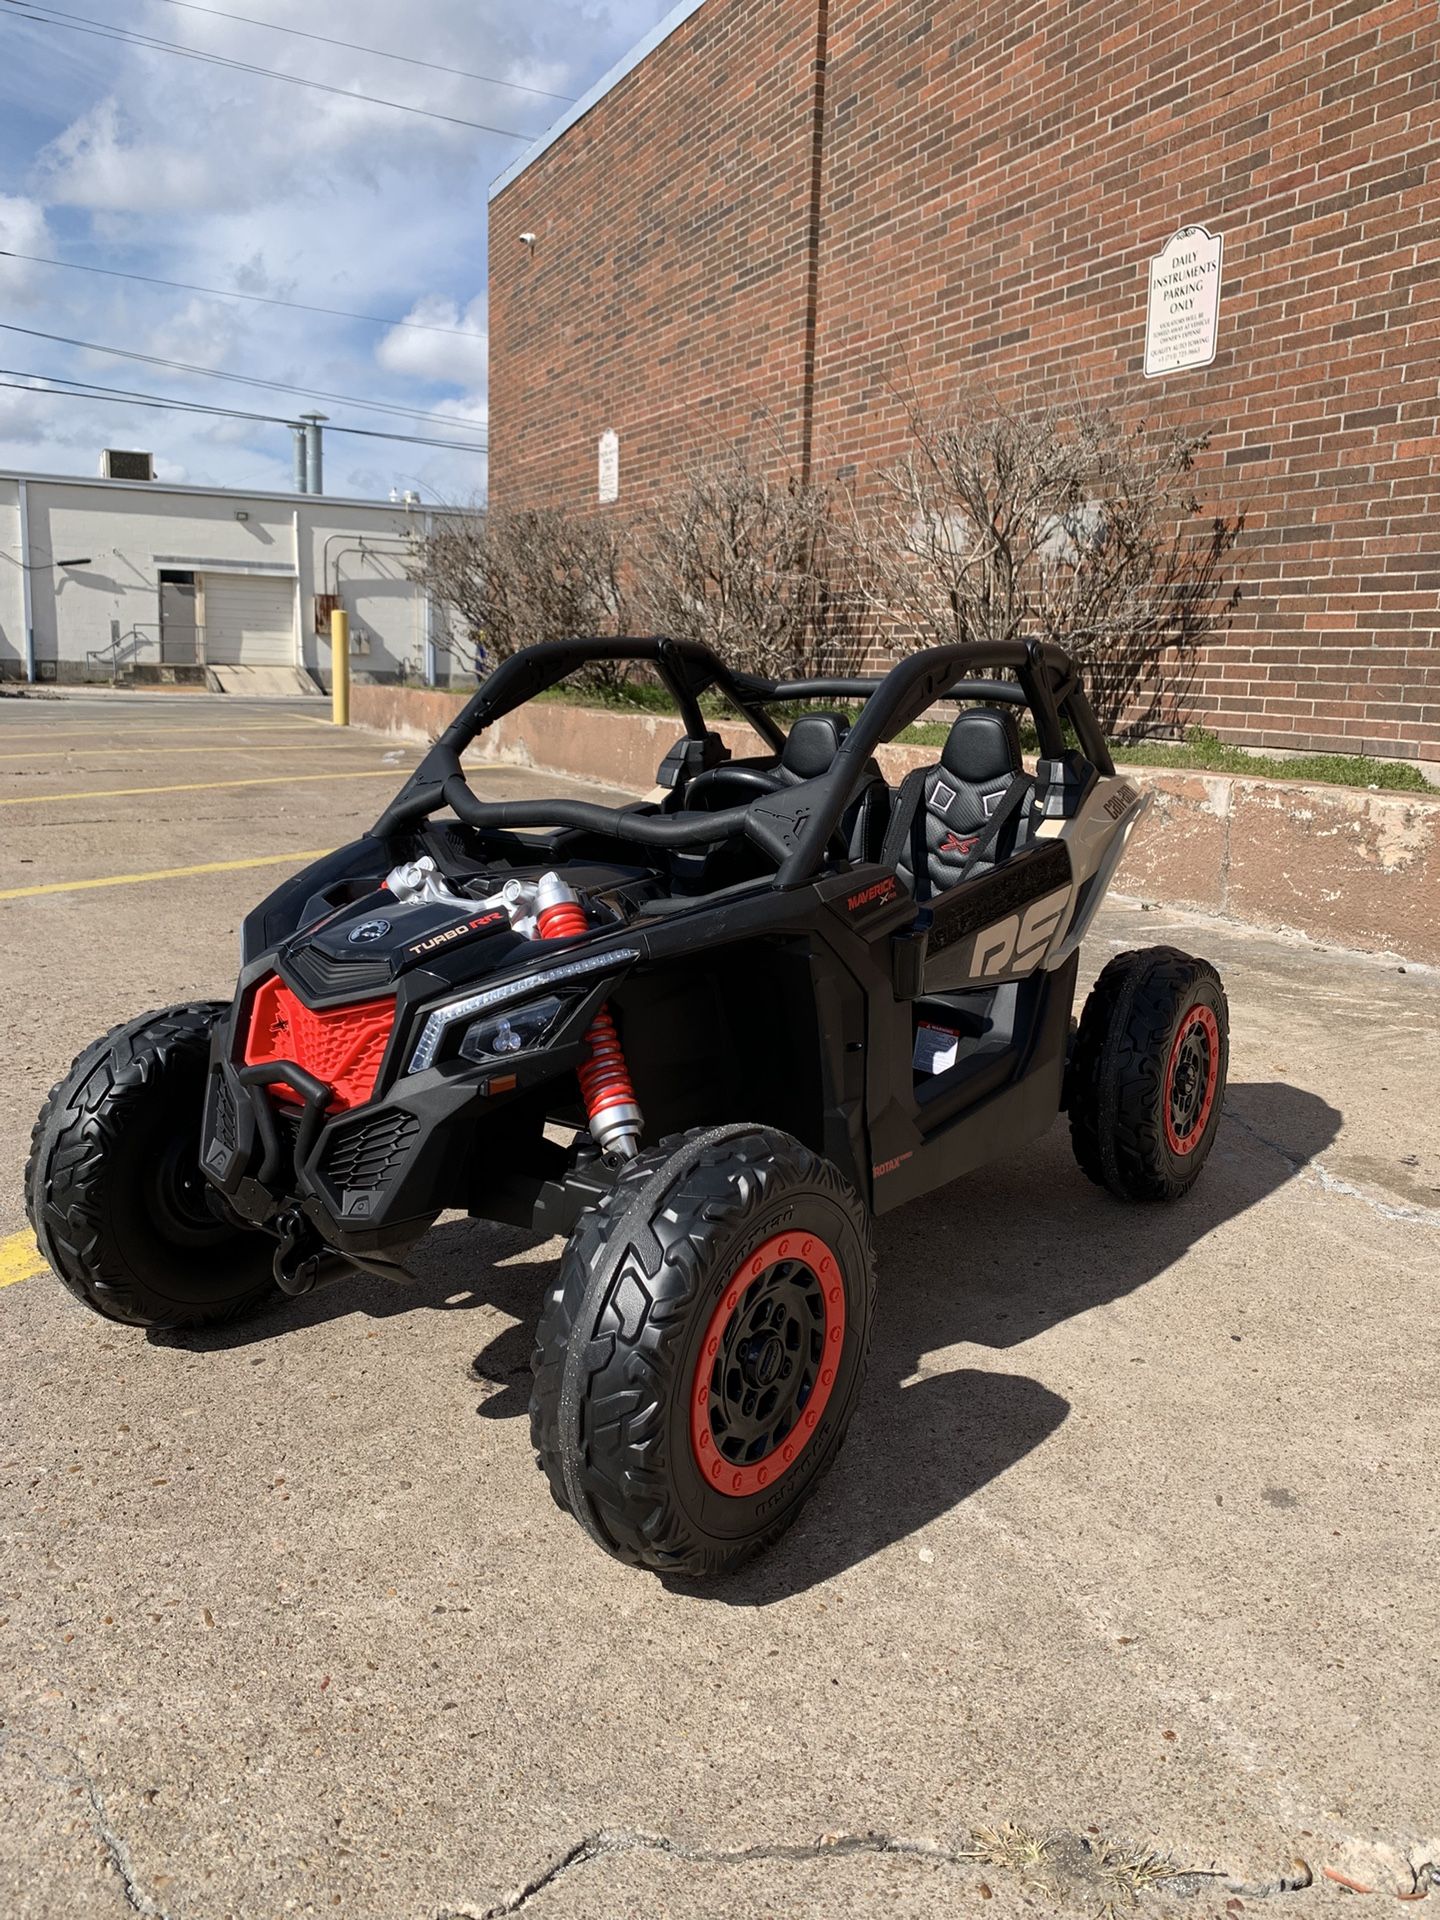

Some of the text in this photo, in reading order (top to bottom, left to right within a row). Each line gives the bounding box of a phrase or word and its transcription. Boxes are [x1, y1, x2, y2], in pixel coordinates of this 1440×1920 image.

[1172, 251, 1198, 269] DAILY
[1153, 262, 1217, 289] INSTRUMENTS
[1163, 280, 1204, 301] PARKING
[1169, 297, 1195, 315] ONLY
[847, 876, 897, 911] MAVERICK
[409, 925, 469, 954] TURBO
